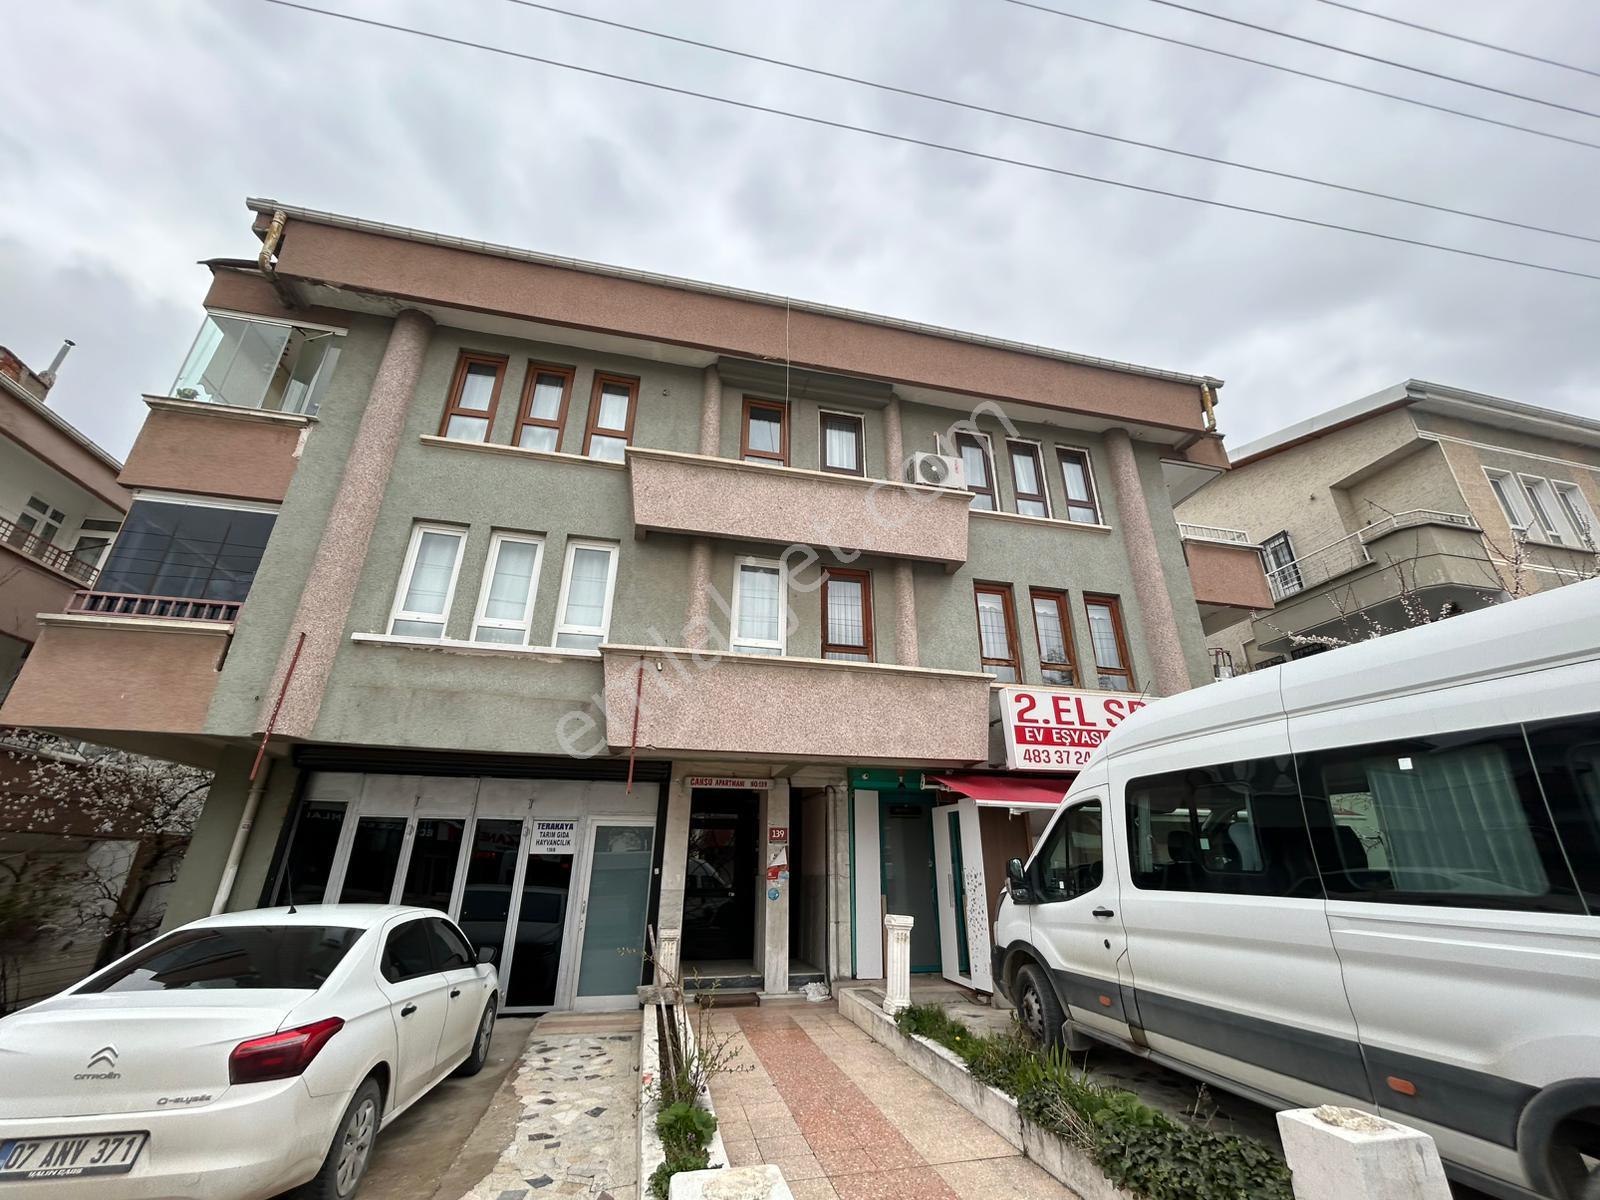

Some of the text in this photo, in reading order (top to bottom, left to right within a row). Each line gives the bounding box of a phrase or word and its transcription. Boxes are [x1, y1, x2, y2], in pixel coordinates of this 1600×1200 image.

[1014, 693, 1097, 727] 2.EL
[1024, 727, 1045, 742] EV
[1023, 748, 1051, 764] 483
[1054, 749, 1071, 764] 37
[537, 822, 574, 831] TERAKAYA
[772, 829, 785, 838] 139
[540, 831, 570, 839] TARIM GIDA
[4, 1137, 138, 1170] 07 ANV 371
